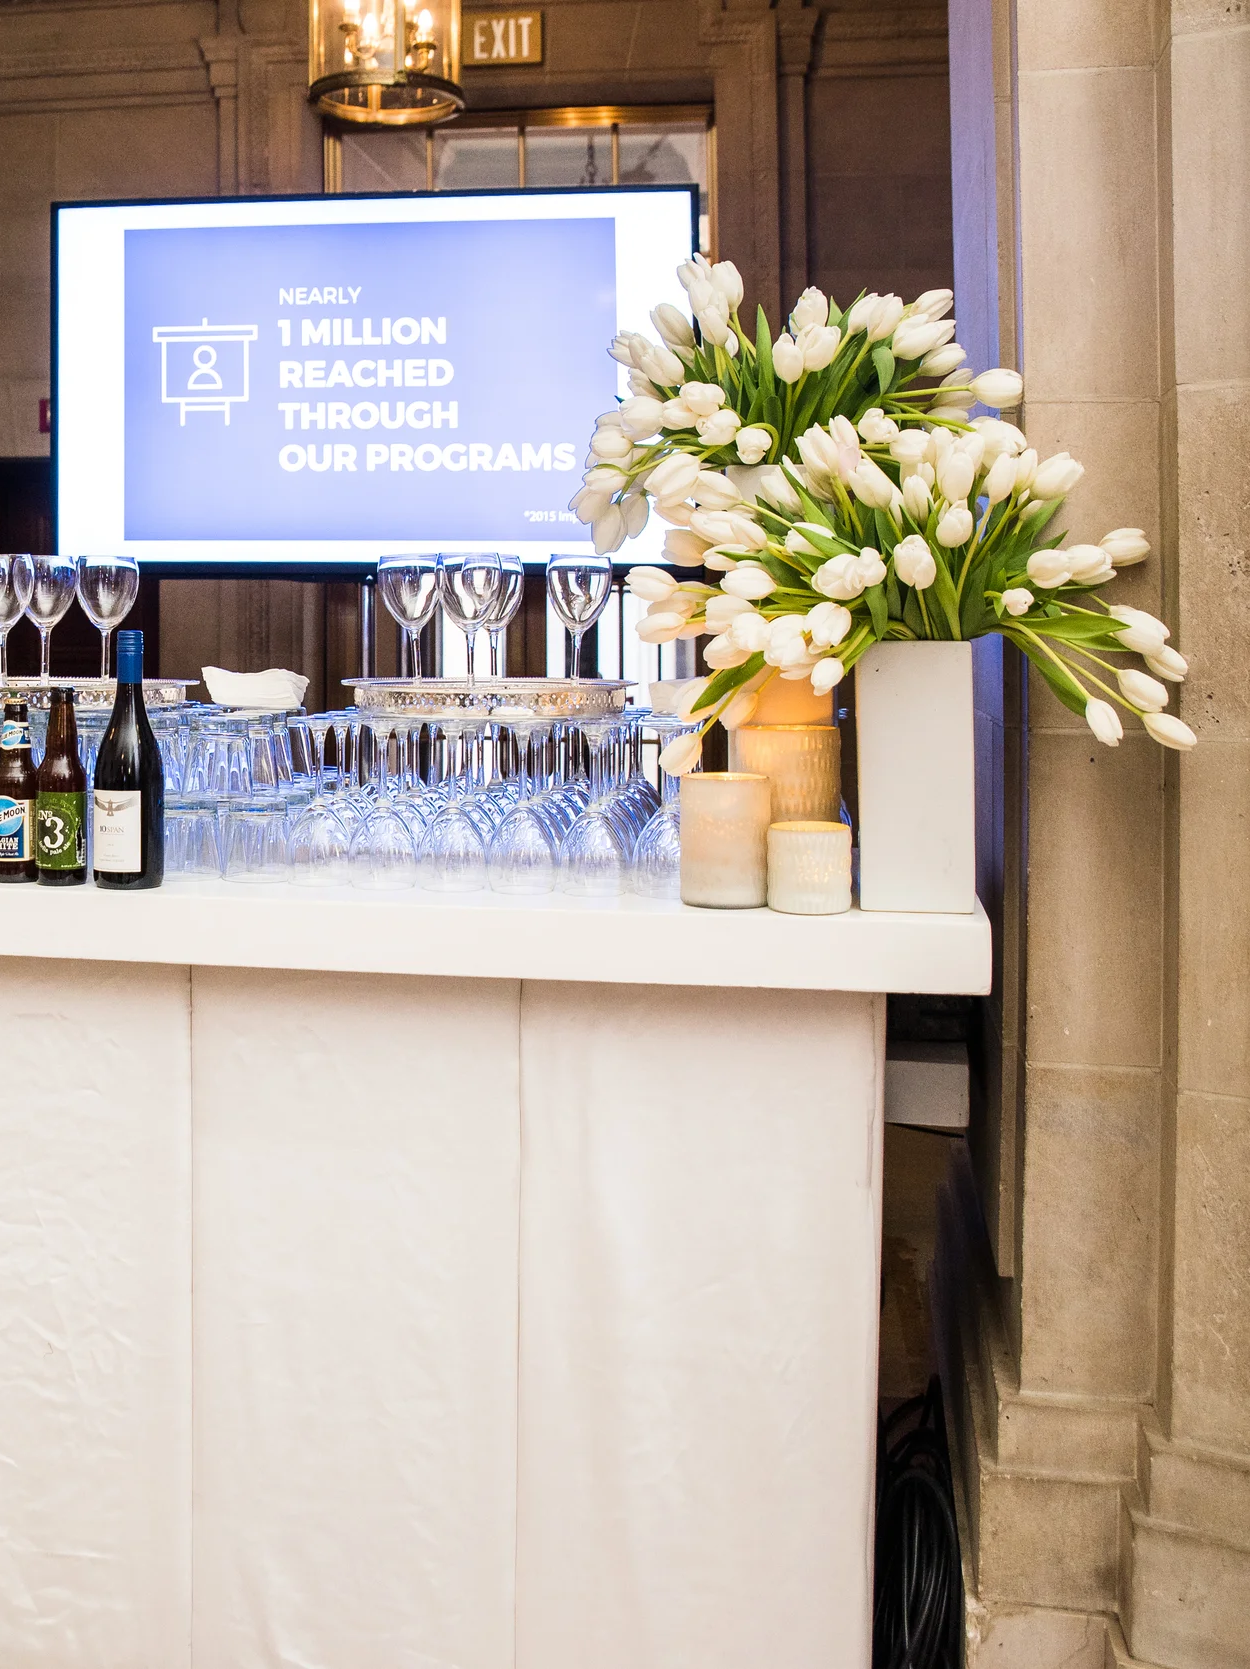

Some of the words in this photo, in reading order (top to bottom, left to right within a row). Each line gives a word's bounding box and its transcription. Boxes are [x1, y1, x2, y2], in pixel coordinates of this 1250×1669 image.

[474, 17, 533, 59] EXIT
[279, 286, 362, 305] NEARLY
[278, 319, 291, 346] 1
[302, 317, 446, 346] MILLION
[279, 358, 454, 388] REACHED
[278, 401, 458, 429] THROUGH
[278, 443, 358, 472] OUR
[366, 442, 576, 471] PROGRAMS
[3, 806, 26, 820] MOON
[44, 816, 64, 848] 3
